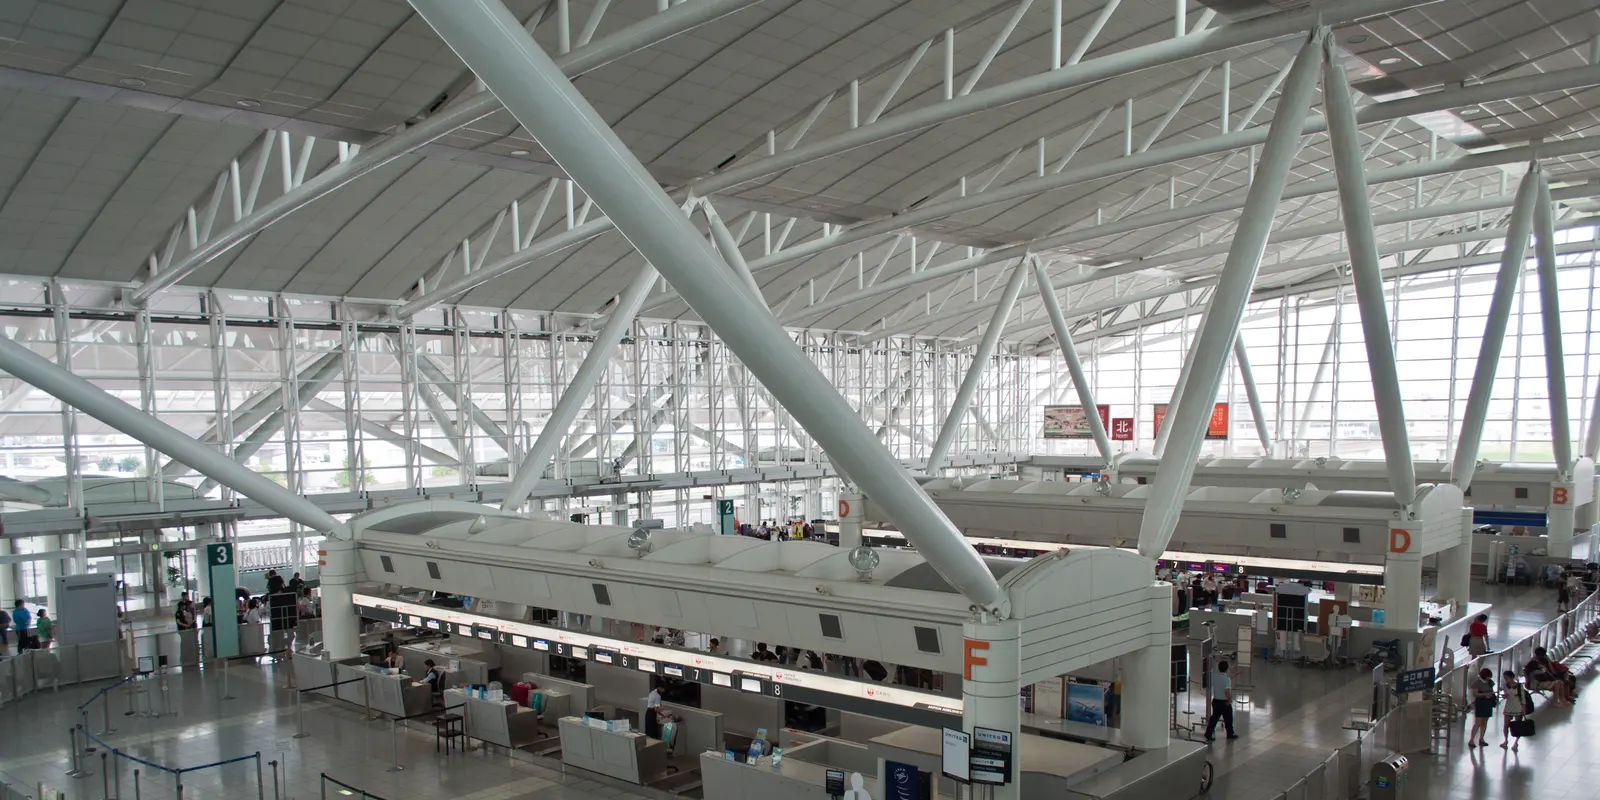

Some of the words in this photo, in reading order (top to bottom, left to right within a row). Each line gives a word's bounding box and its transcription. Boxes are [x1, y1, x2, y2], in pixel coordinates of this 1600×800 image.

[1116, 420, 1128, 433] 北
[1552, 487, 1568, 504] B
[725, 502, 731, 513] 2
[839, 500, 850, 518] D
[1390, 528, 1410, 553] D
[216, 546, 227, 564] 3
[399, 614, 403, 622] 2
[446, 623, 451, 633] 3
[500, 633, 504, 643] 4
[558, 644, 562, 654] 5
[622, 656, 627, 666] 6
[964, 640, 990, 680] F
[694, 669, 699, 680] 7
[774, 685, 780, 696] 8
[945, 732, 962, 741] UNITED
